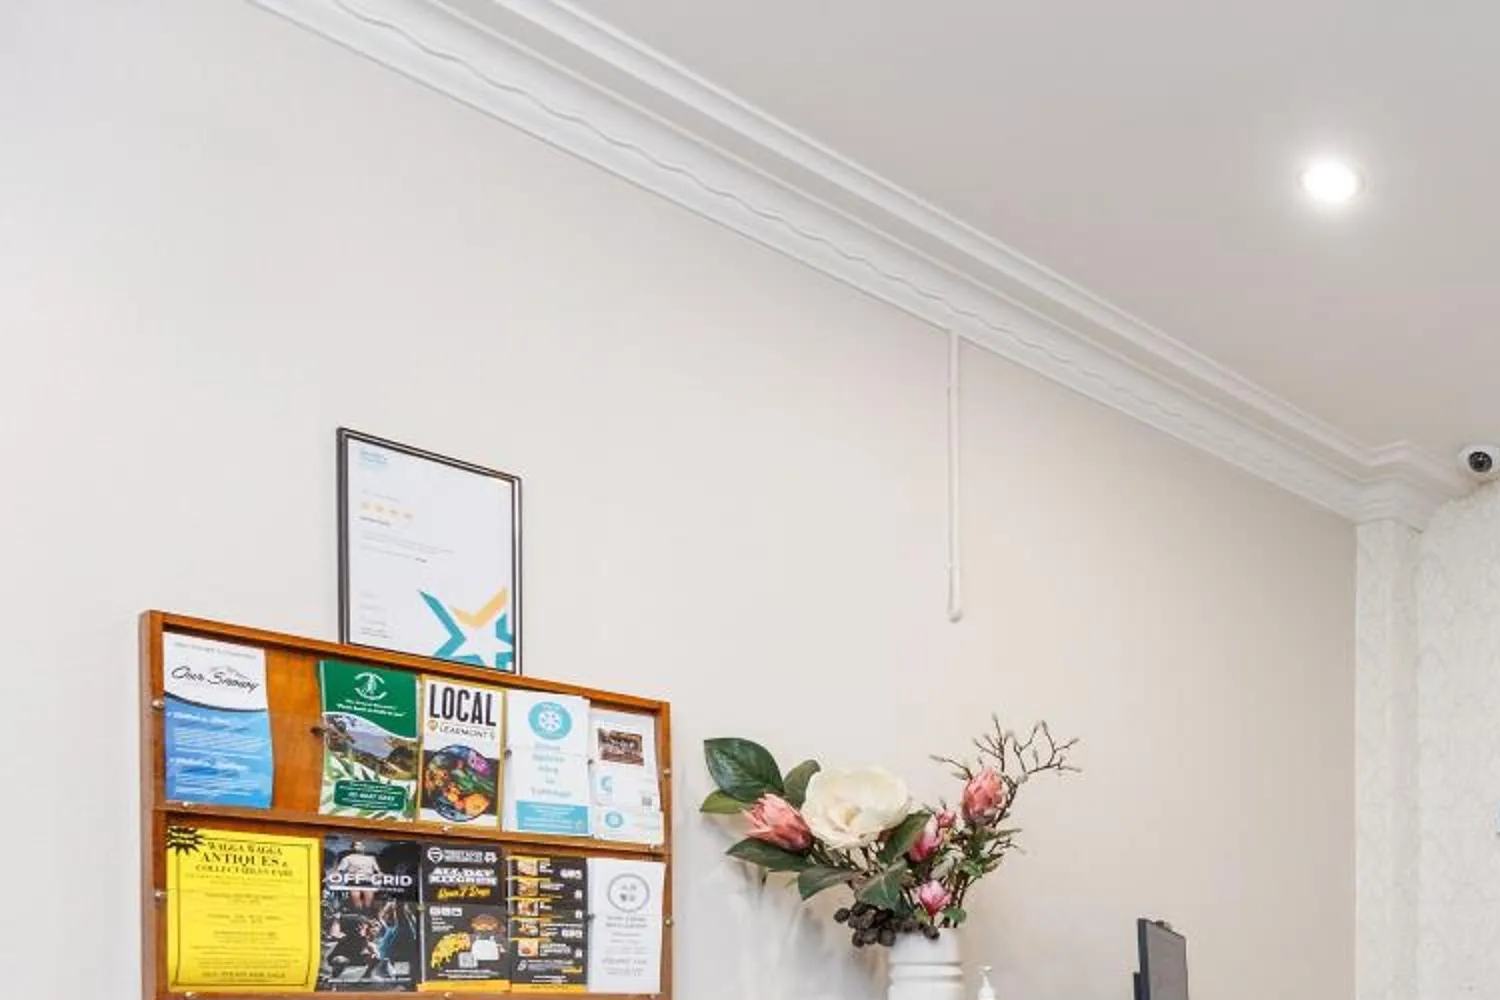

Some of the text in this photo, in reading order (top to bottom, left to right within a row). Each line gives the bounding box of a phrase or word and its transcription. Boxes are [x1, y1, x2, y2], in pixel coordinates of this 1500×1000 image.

[207, 671, 260, 694] Snowy
[429, 683, 497, 727] LOCAL
[201, 851, 279, 867] ANTIQUES
[328, 873, 413, 887] OFF GRID
